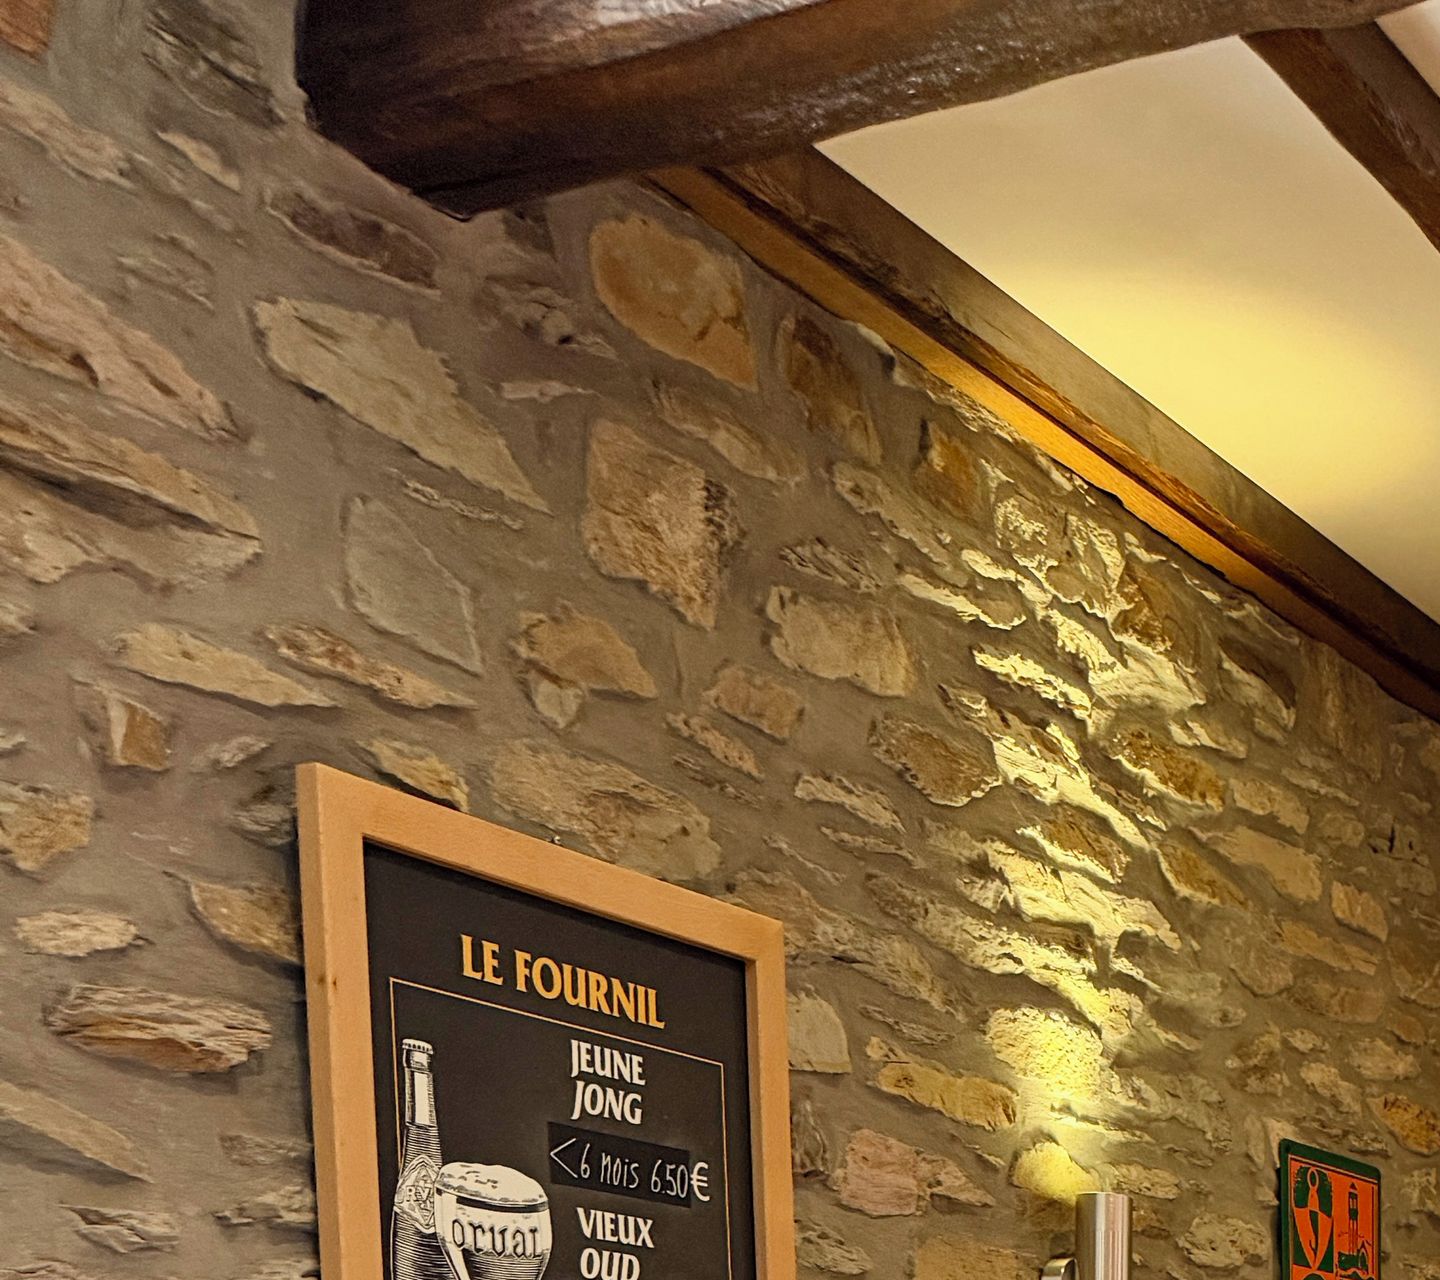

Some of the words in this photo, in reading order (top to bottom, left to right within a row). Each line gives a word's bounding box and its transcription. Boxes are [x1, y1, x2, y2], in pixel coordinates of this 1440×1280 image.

[460, 934, 504, 986] LE
[514, 949, 666, 1030] FOURNIL
[570, 1039, 646, 1086] JEUNE
[570, 1080, 643, 1125] JONG
[576, 1206, 655, 1249] VIEUX
